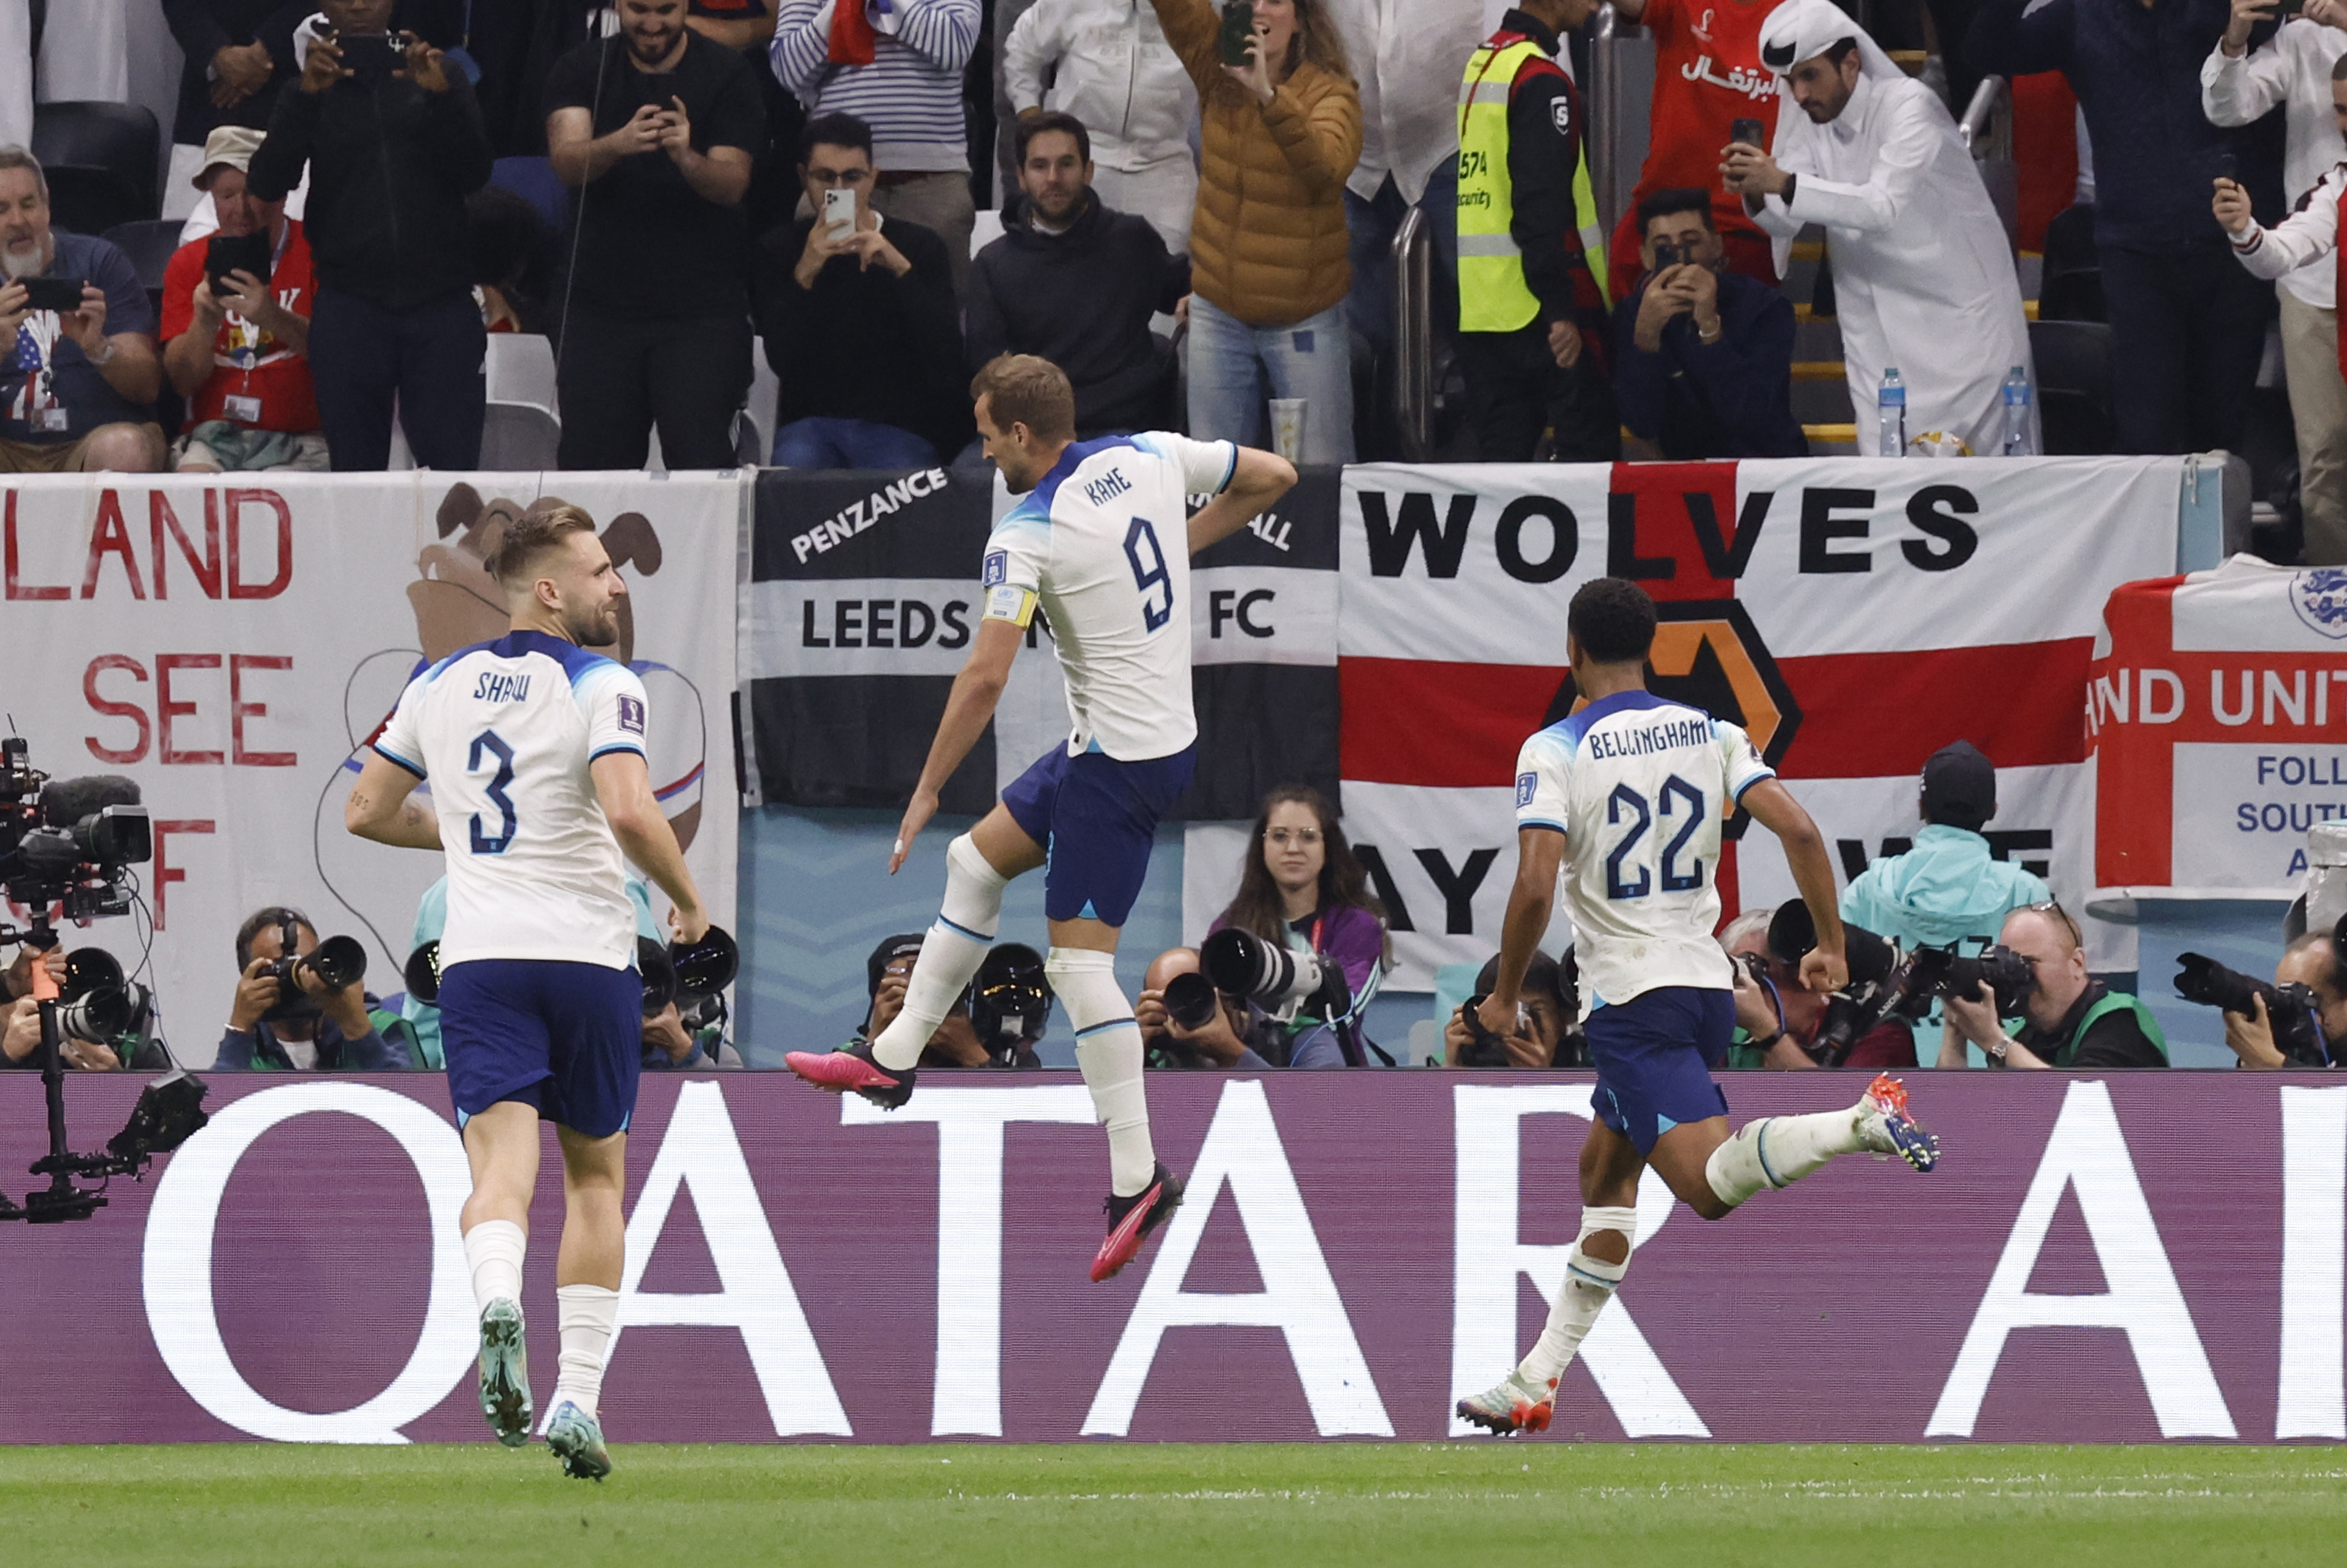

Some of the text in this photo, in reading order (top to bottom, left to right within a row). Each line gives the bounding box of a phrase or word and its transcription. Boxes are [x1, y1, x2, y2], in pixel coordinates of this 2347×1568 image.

[791, 467, 948, 565] PENZANCE
[1084, 467, 1132, 507] KANE
[1357, 485, 1980, 583] WOLVES
[5, 488, 292, 600] LAND
[1123, 516, 1174, 634] 9
[803, 599, 970, 648] LEEDS
[1210, 589, 1276, 639] FC
[83, 653, 297, 766] SEE
[473, 671, 531, 703] SHAW
[1589, 719, 1707, 759] BELLINGHAM
[468, 729, 516, 854] 3
[1606, 773, 1704, 899] 22
[2236, 802, 2347, 833] SOUT
[142, 1080, 1713, 1444] QATAR
